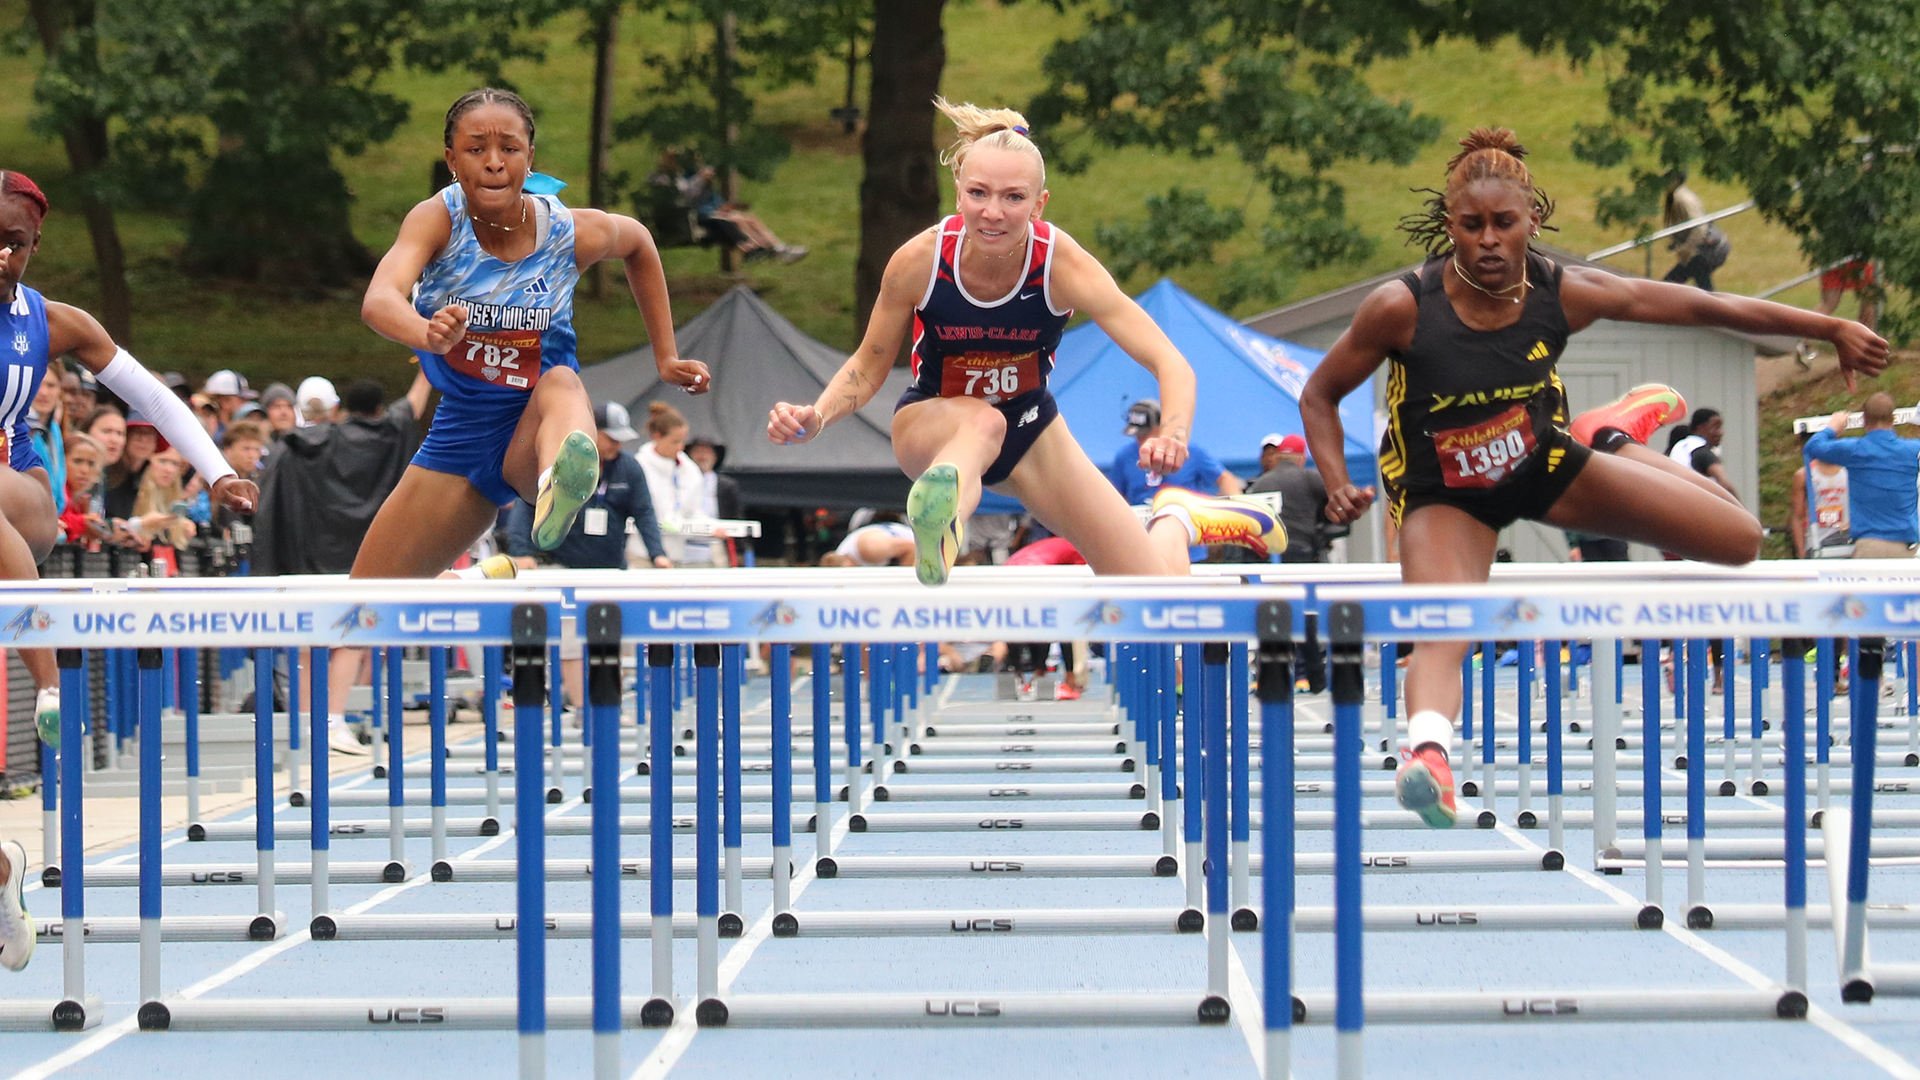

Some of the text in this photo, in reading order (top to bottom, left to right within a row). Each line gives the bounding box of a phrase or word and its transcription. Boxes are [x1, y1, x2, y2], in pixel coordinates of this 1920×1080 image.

[501, 305, 552, 331] WILSON
[934, 325, 1041, 341] LEWIS-CLARK
[465, 340, 520, 370] 782
[964, 366, 1019, 396] 736
[1454, 429, 1526, 477] 1390
[72, 611, 314, 634] UNC ASHEVILLE
[398, 610, 481, 633] UCS
[649, 608, 731, 629] UCS
[817, 607, 1058, 629] UNC ASHEVILLE
[1141, 605, 1225, 629] UCS
[1389, 604, 1474, 628] UCS
[1560, 602, 1801, 626] UNC ASHEVILLE
[191, 871, 243, 883] UCS
[970, 861, 1022, 872] UCS
[950, 919, 1013, 932] UCS
[1416, 912, 1478, 926] UCS
[368, 1007, 444, 1023] UCS
[925, 1000, 1001, 1017] UCS
[1503, 999, 1578, 1015] UCS
